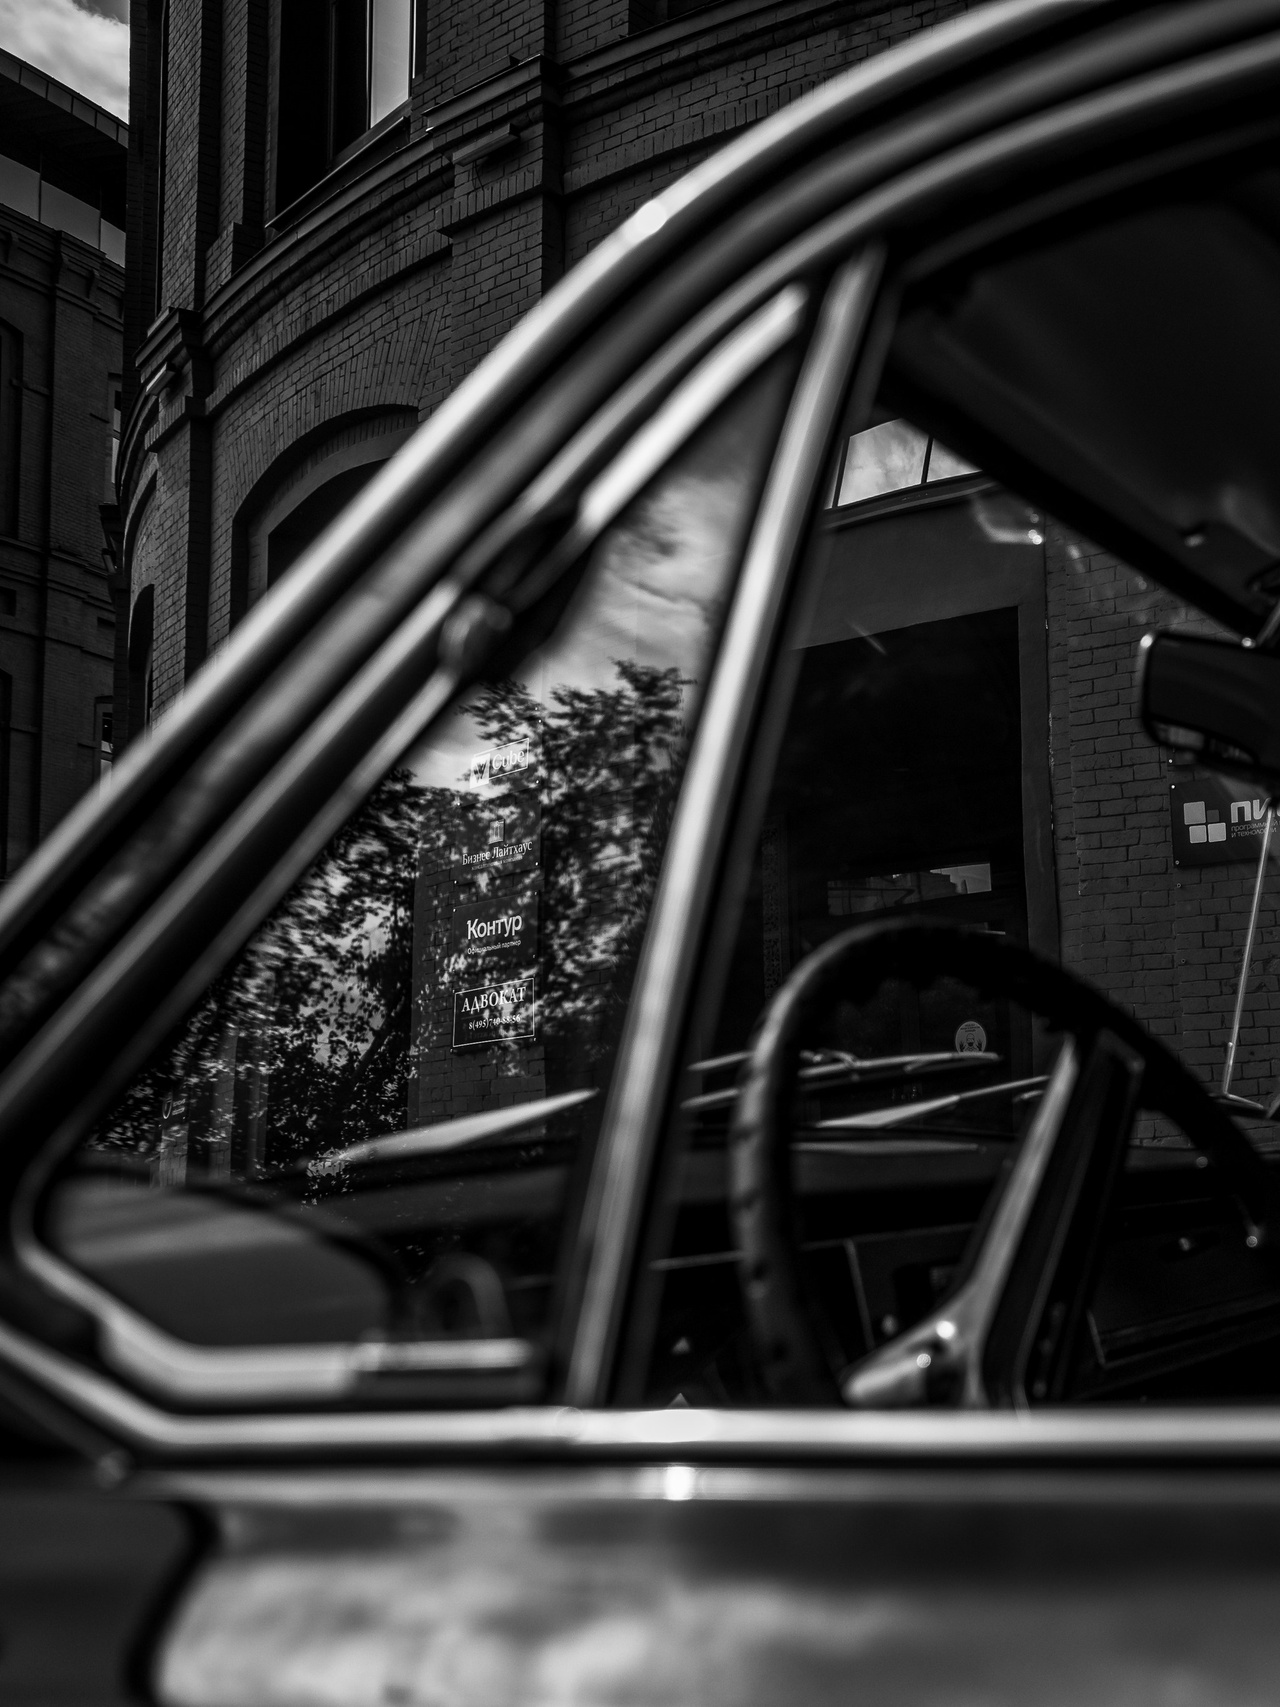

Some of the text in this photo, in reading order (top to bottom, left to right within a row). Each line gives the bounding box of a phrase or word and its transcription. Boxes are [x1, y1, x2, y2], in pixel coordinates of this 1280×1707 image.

[492, 750, 525, 770] Cube
[462, 851, 491, 866] Бизнес
[492, 841, 533, 859] Лайтхаус
[466, 915, 523, 940] Контур
[461, 986, 526, 1015] АДВОКАТ
